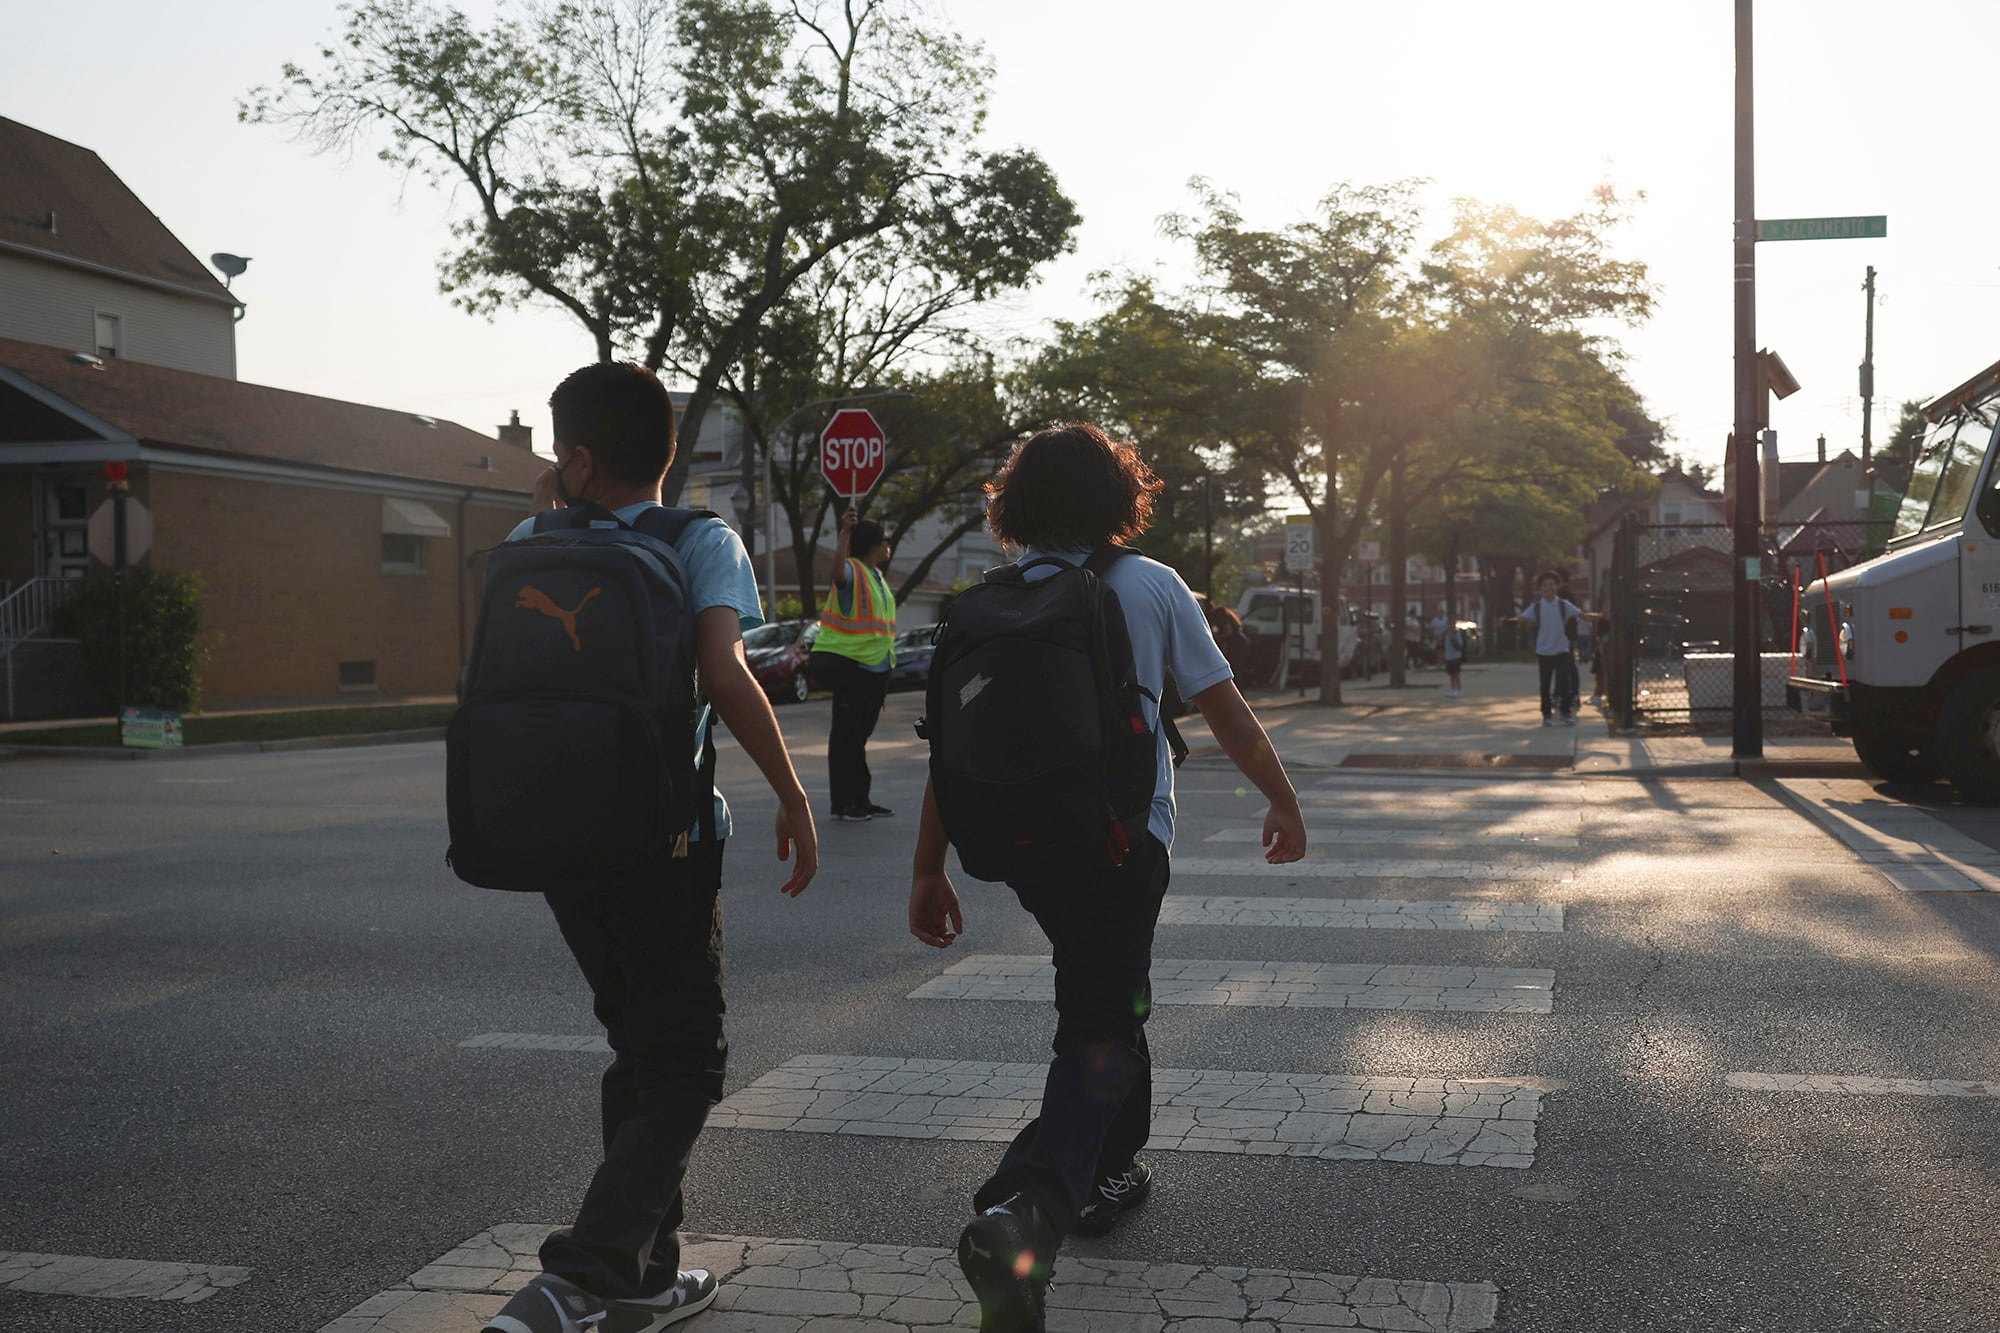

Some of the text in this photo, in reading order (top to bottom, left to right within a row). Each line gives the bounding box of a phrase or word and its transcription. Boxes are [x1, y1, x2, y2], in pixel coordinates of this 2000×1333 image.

[1783, 219, 1866, 238] SACRAMENTO
[825, 437, 882, 470] STOP
[1289, 540, 1310, 553] 20
